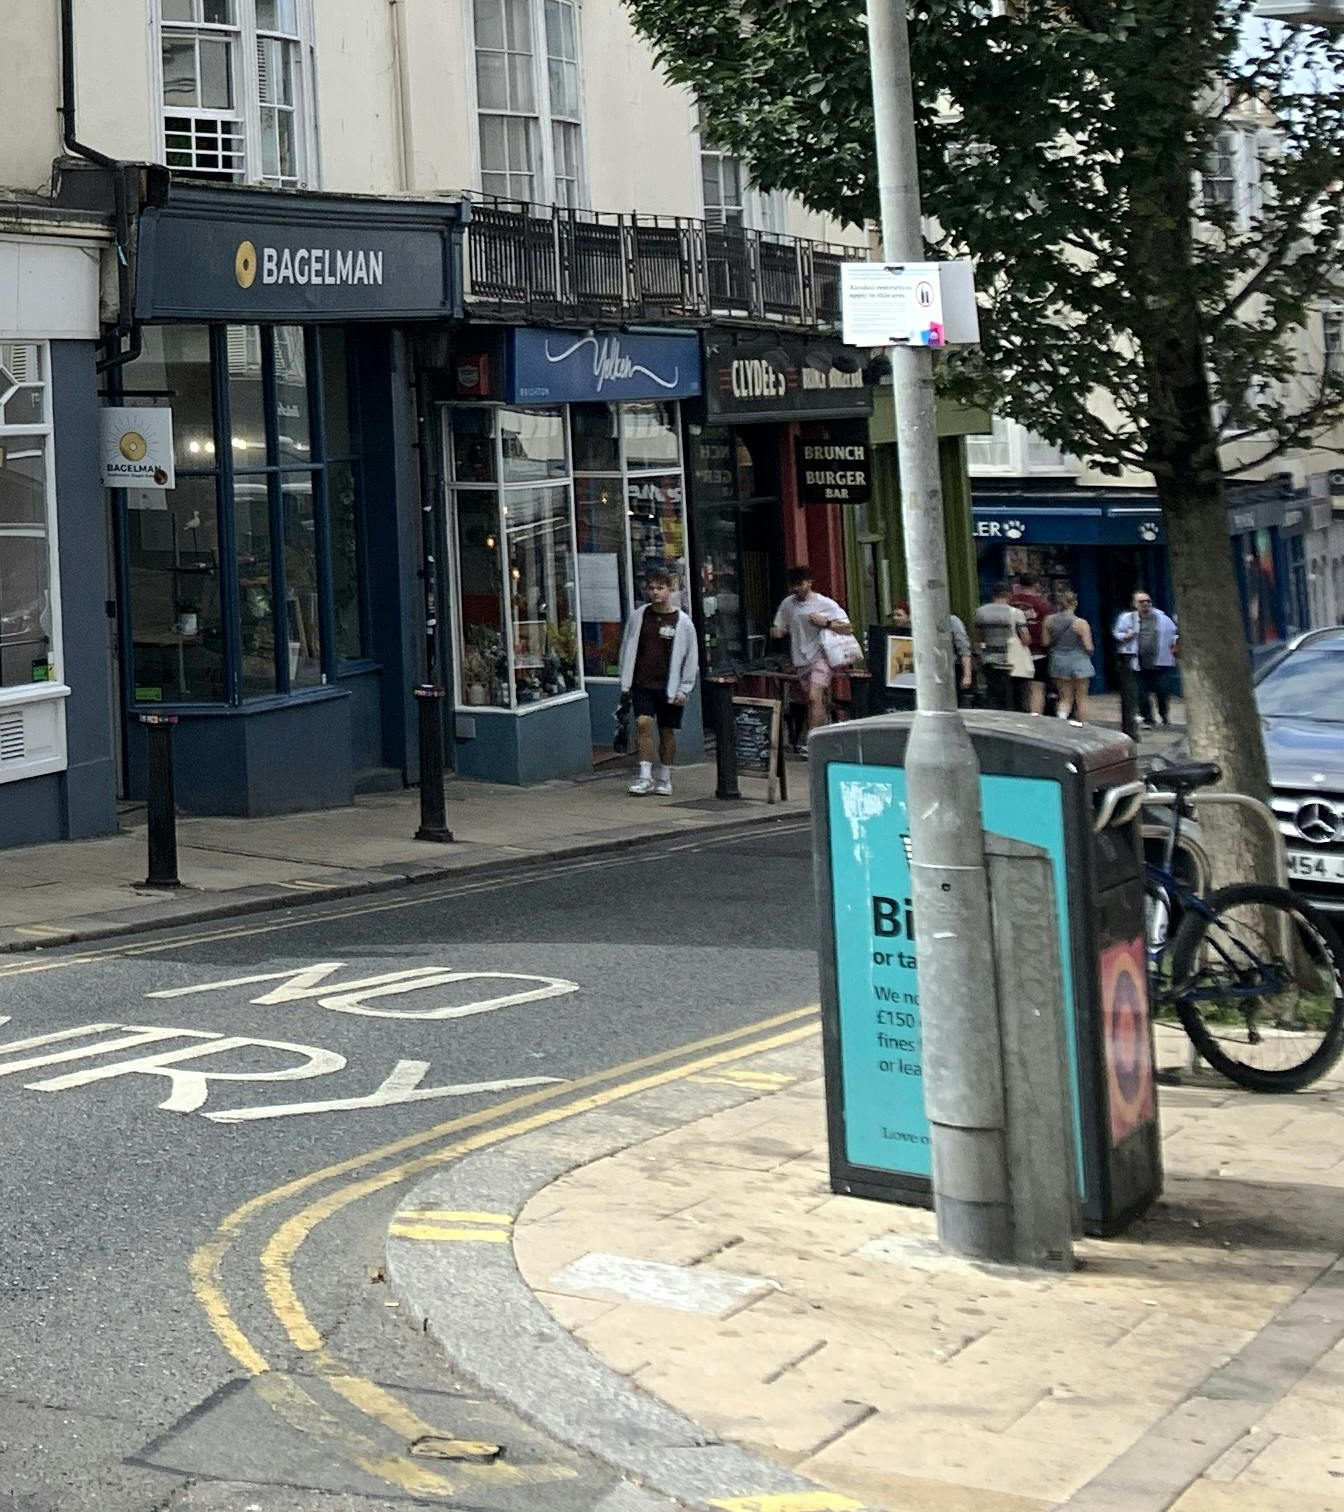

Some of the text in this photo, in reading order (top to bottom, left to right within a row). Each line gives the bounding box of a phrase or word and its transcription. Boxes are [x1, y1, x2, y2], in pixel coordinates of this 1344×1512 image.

[263, 247, 383, 285] BAGELMAN
[804, 446, 865, 460] BRUNCH
[805, 471, 866, 486] BURGER
[825, 488, 849, 499] BAR
[872, 895, 915, 941] Bi
[873, 952, 917, 969] or ta
[145, 961, 580, 1021] NO
[874, 986, 900, 1004] We
[877, 1009, 916, 1029] £150
[878, 1032, 915, 1052] fines
[879, 1058, 922, 1076] or lea
[882, 1126, 914, 1144] Love
